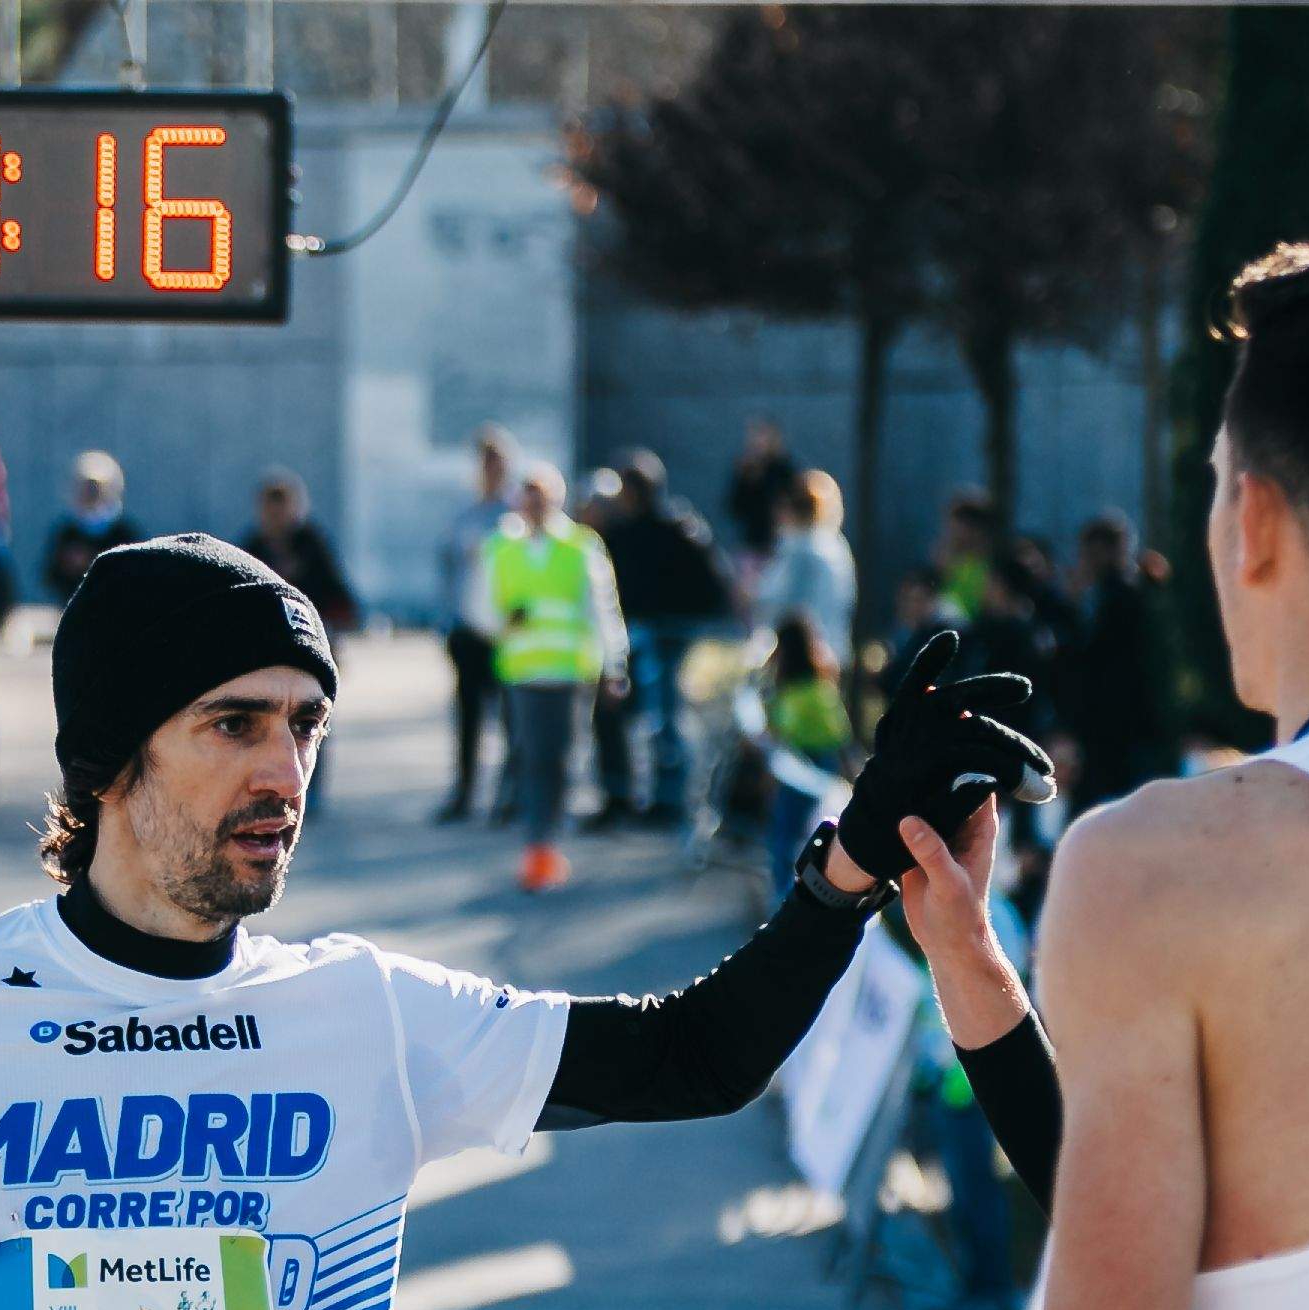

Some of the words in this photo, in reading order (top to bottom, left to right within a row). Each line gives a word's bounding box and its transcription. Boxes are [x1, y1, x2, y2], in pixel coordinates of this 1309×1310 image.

[63, 1015, 262, 1055] Sabadell
[25, 1191, 177, 1230] CORRE
[186, 1191, 265, 1226] POR
[99, 1257, 211, 1283] MetLife
